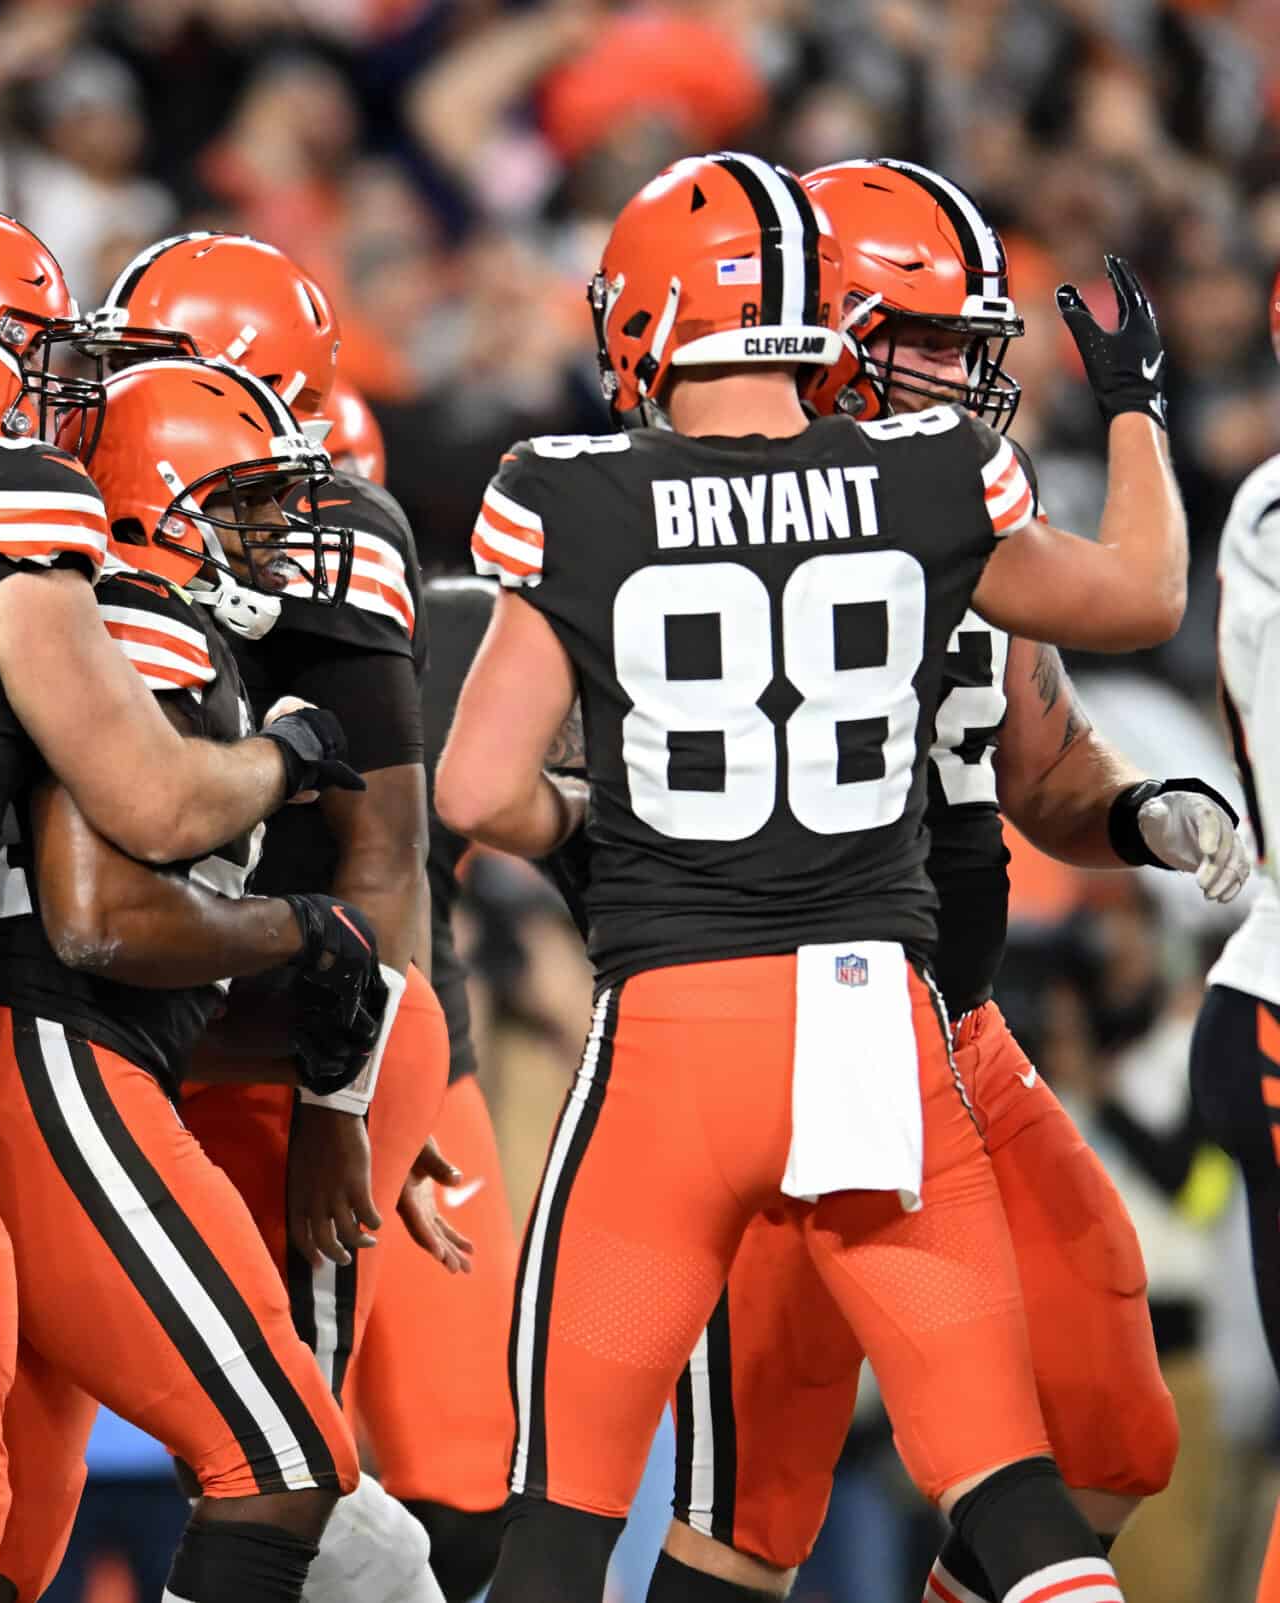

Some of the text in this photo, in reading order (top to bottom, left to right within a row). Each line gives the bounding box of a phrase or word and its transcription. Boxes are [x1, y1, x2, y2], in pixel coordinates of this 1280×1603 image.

[743, 336, 827, 356] CLEVELAND
[650, 464, 881, 550] BRYANT
[613, 549, 927, 842] 88
